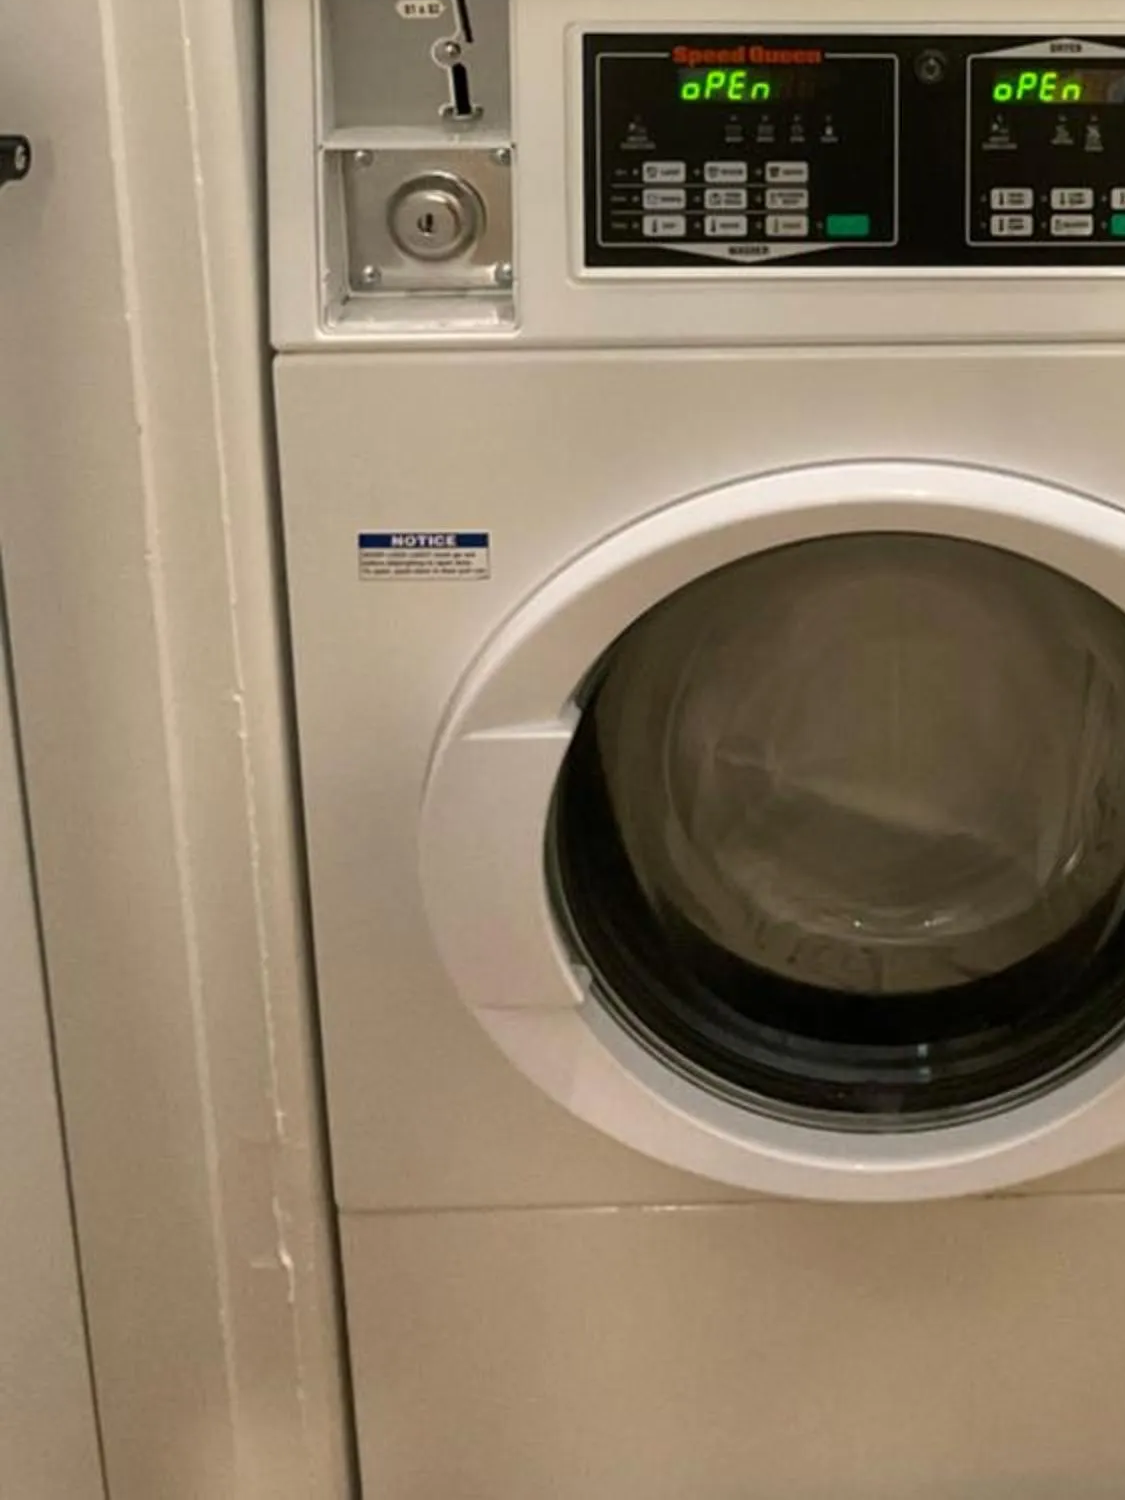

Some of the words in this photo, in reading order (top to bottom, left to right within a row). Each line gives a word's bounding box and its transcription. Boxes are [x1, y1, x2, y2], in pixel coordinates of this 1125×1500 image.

[672, 46, 746, 67] Speed
[749, 46, 823, 65] Queen
[391, 535, 457, 546] NOTICE
